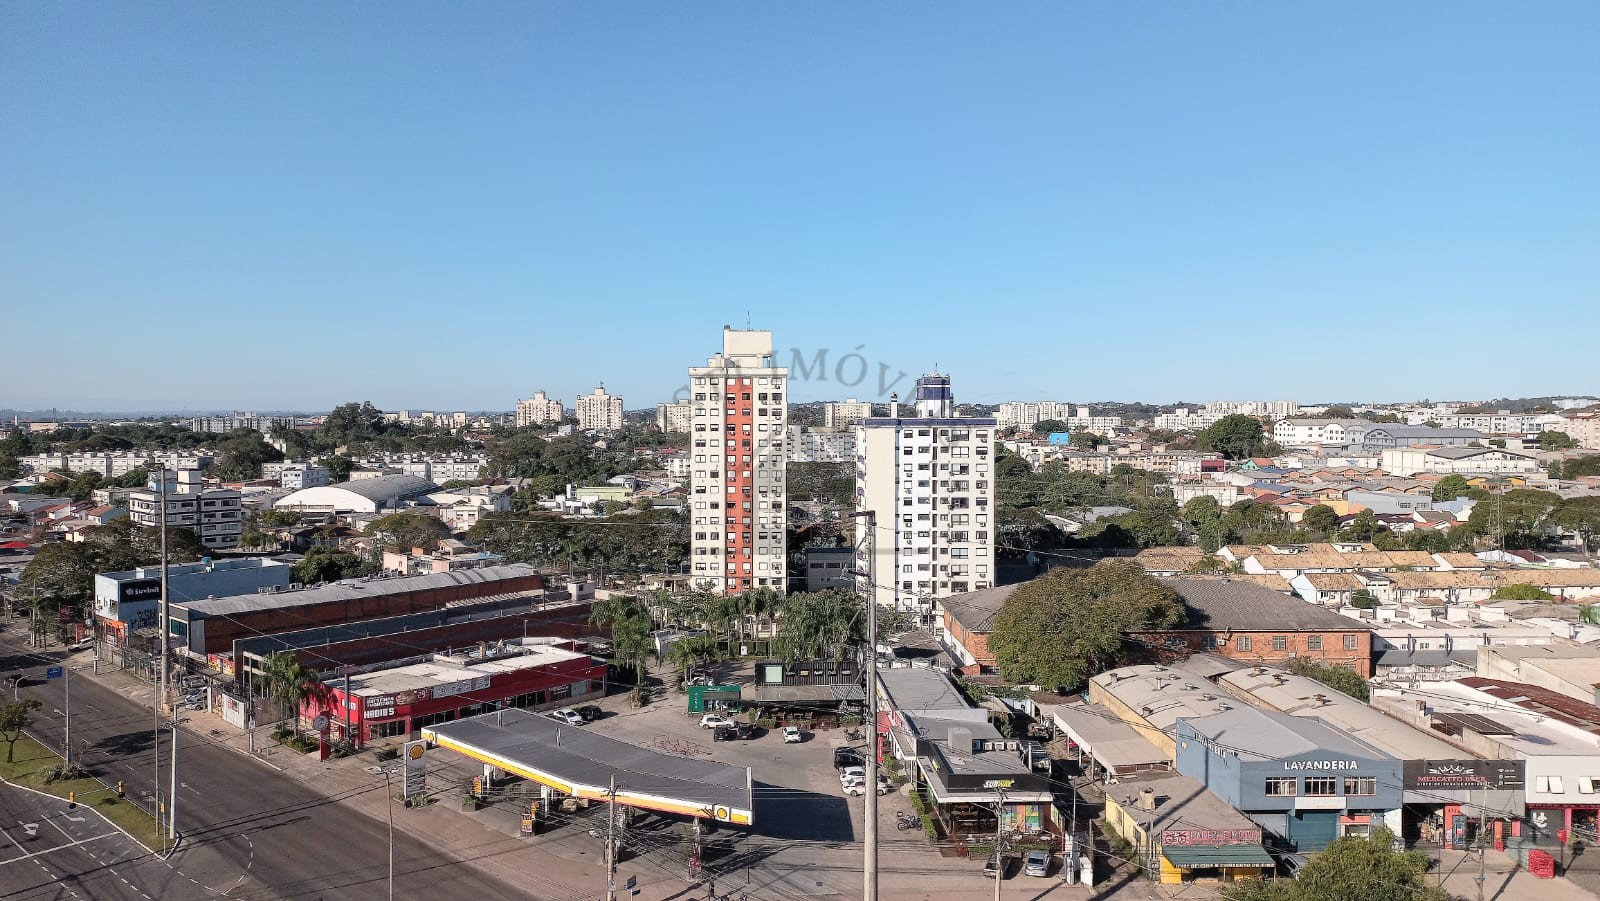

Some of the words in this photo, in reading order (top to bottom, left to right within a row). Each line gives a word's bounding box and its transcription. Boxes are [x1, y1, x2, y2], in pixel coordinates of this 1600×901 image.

[134, 586, 159, 595] Suvinil
[363, 707, 395, 719] HABIBS
[1284, 760, 1358, 770] LAVANDERIA
